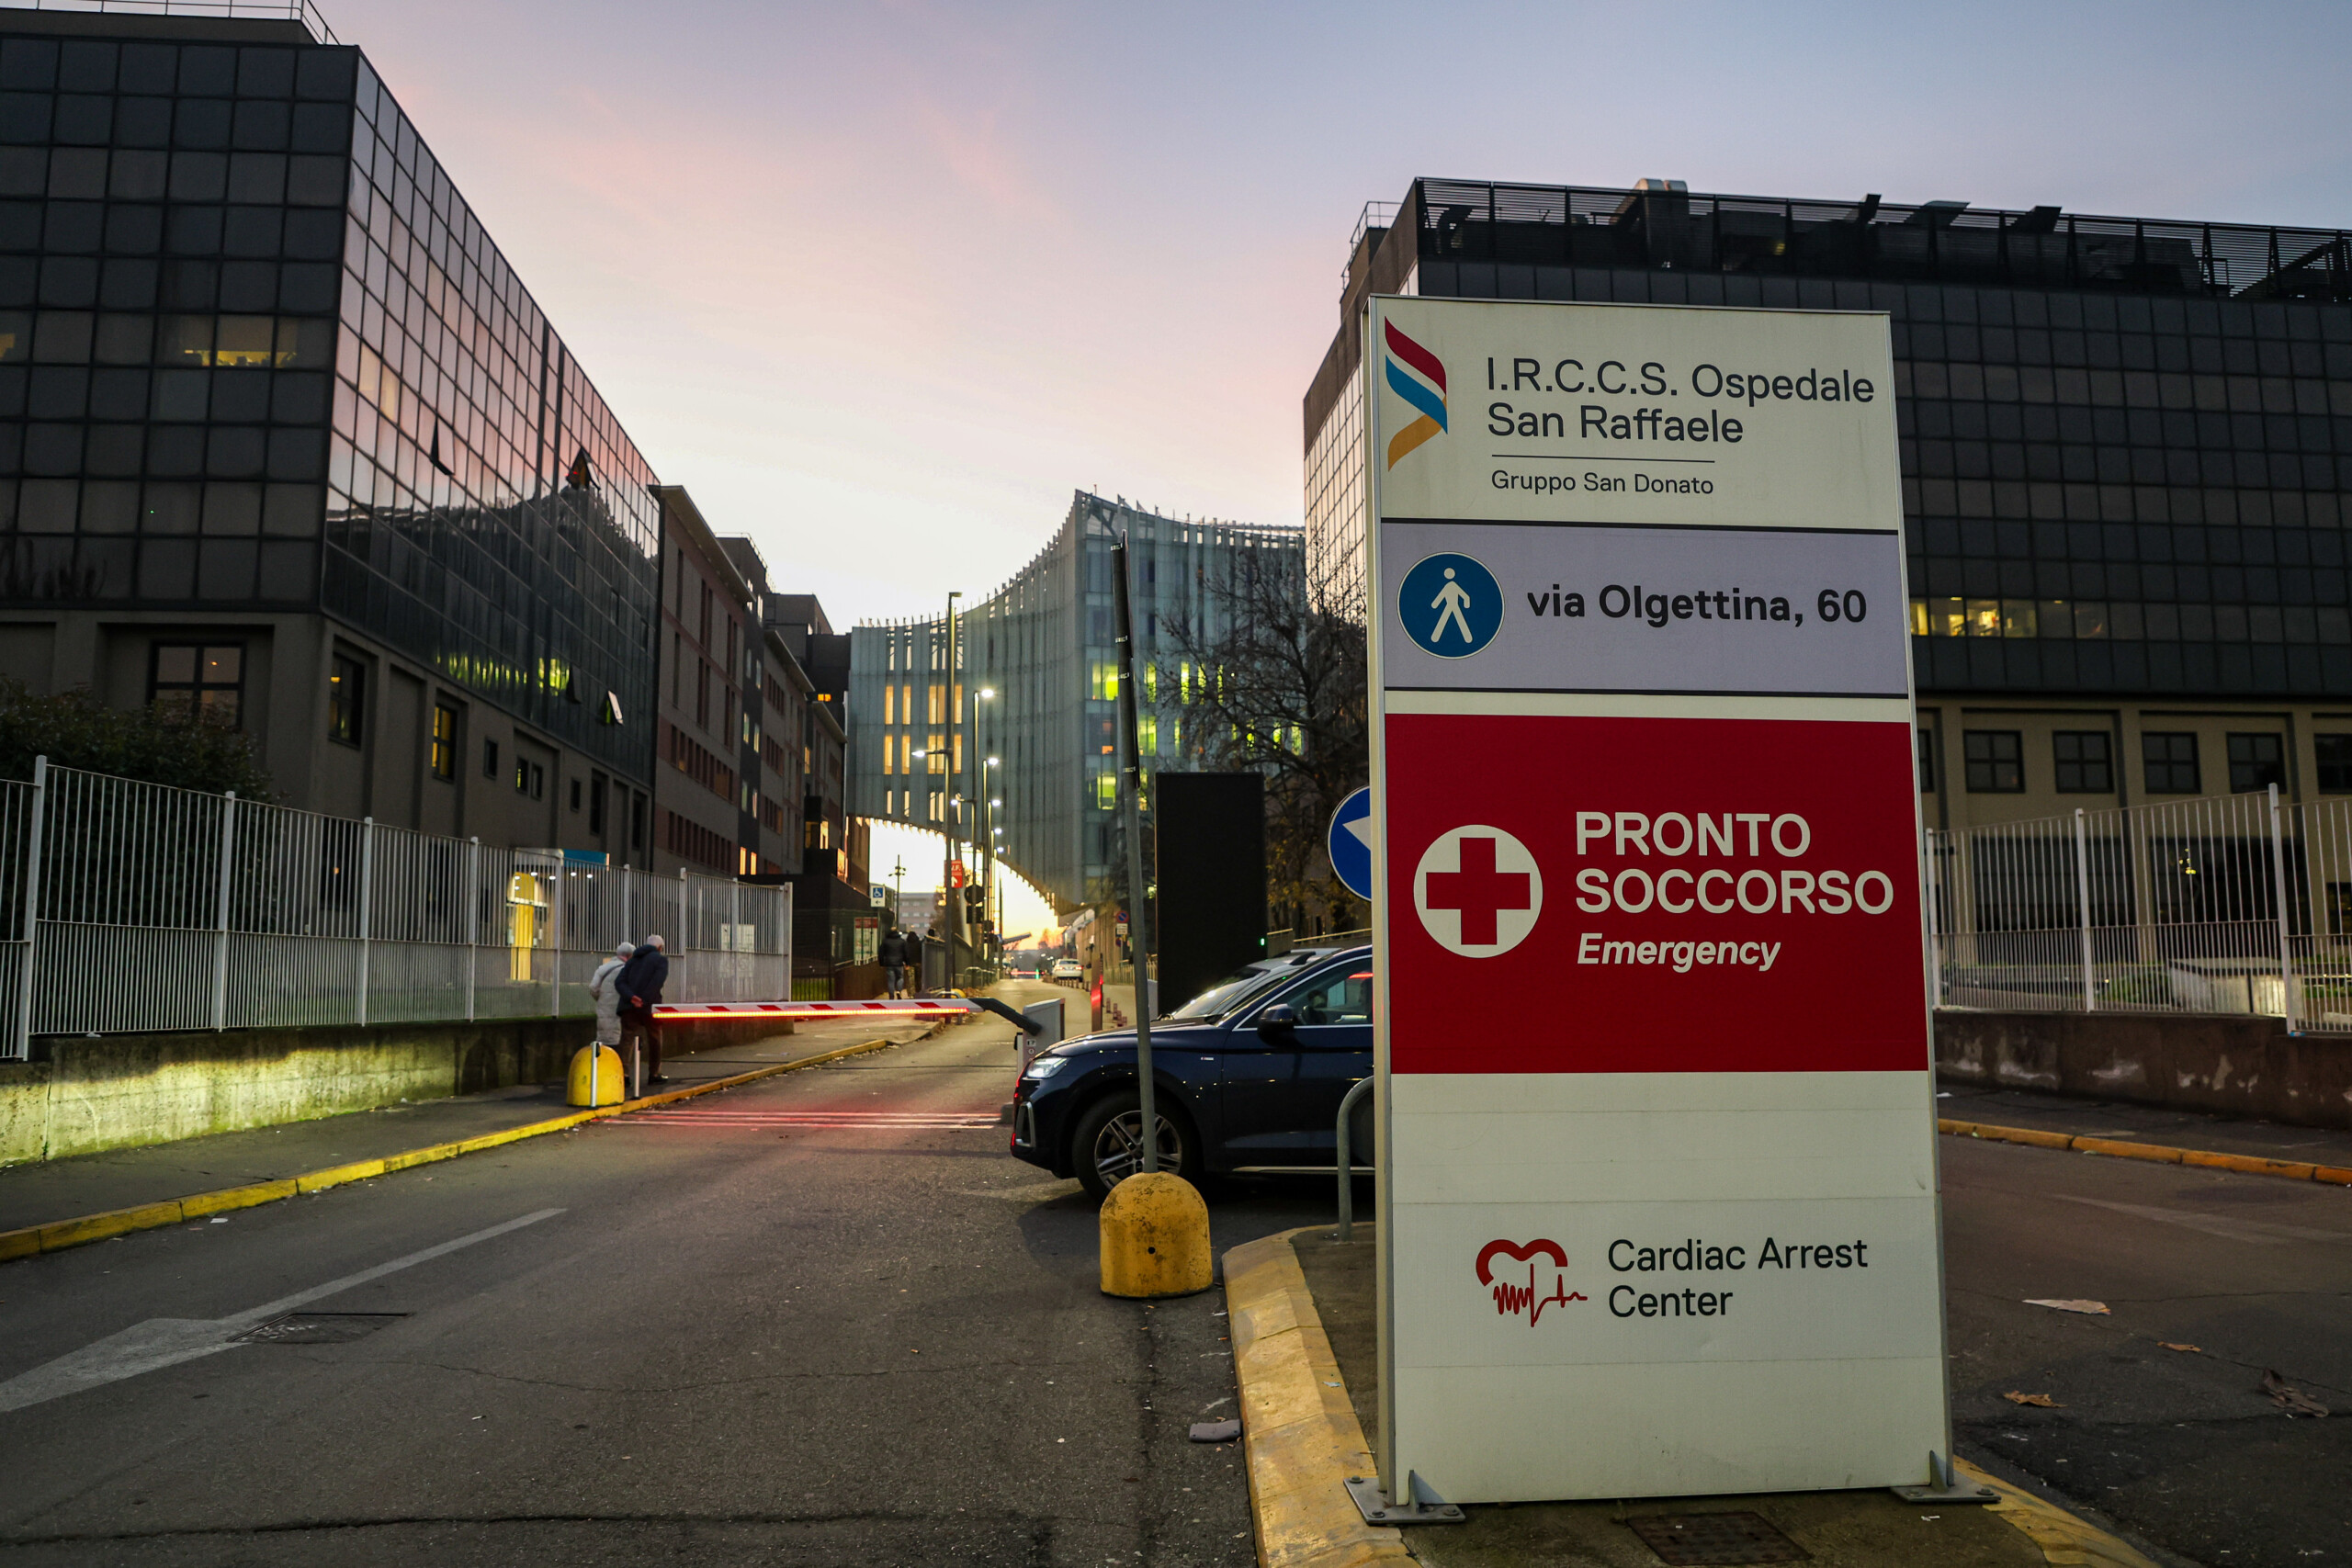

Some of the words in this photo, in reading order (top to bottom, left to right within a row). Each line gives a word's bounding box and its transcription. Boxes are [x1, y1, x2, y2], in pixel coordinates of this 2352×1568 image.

[1487, 356, 1678, 396] I.R.C.C.S.
[1691, 364, 1874, 408] Ospedale
[1487, 401, 1565, 438] San
[1580, 404, 1744, 444] Raffaele
[1491, 469, 1577, 495] Gruppo
[1583, 471, 1626, 492] San
[1634, 473, 1714, 495] Donato
[1527, 583, 1586, 618] via
[1599, 584, 1804, 628] Olgettina,
[1817, 588, 1867, 623] 60
[1576, 811, 1811, 857] PRONTO
[1576, 868, 1894, 915] SOCCORSO
[1577, 932, 1781, 974] Emergency
[1608, 1238, 1747, 1272] Cardiac
[1758, 1236, 1869, 1269] Arrest
[1609, 1284, 1734, 1318] Center
